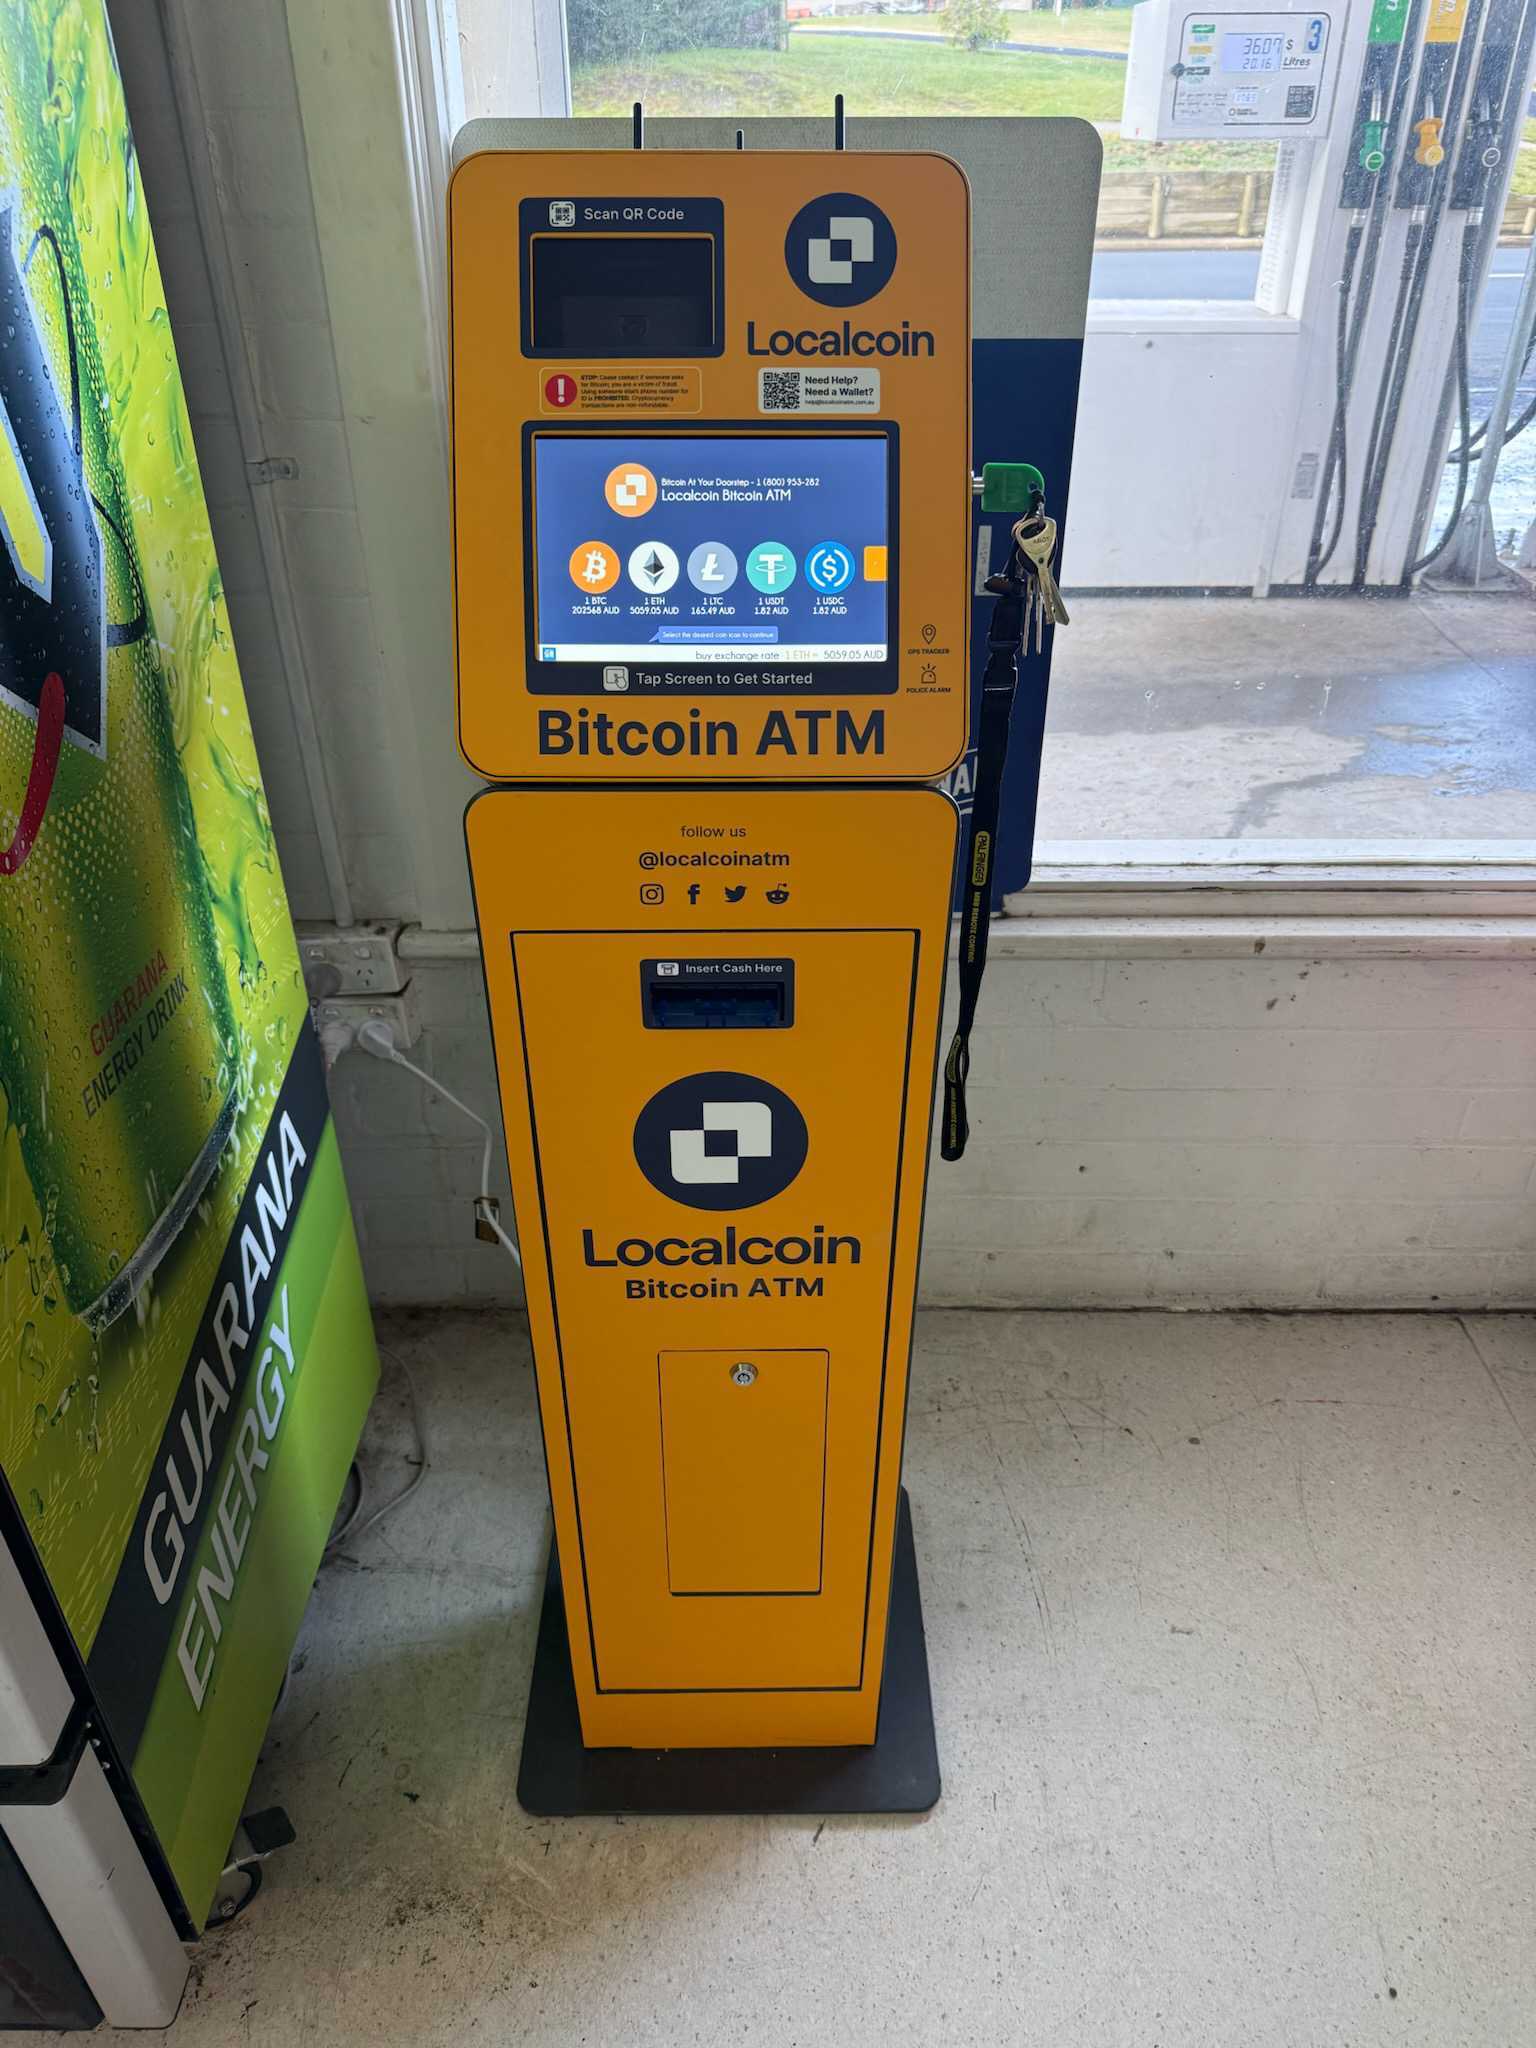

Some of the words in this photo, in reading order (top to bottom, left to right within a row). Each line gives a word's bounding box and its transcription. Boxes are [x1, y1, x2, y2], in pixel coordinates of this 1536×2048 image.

[1307, 19, 1322, 51] 3
[1282, 56, 1311, 67] Litres
[584, 207, 617, 222] Scan
[622, 207, 643, 222] QR
[646, 207, 685, 222] Code
[747, 320, 935, 357] Localcoin
[804, 375, 830, 385] Need
[831, 375, 859, 386] Help?
[804, 387, 830, 396] Need
[839, 387, 874, 396] Wallet?
[661, 477, 686, 487] Bitcoin
[687, 477, 697, 487] At
[698, 477, 714, 487] Your
[715, 477, 750, 487] Doorstep
[762, 477, 785, 488] (800)
[786, 477, 820, 487] 953-282
[661, 488, 720, 501] Localcoin
[722, 488, 763, 501] Bitcoin
[766, 488, 792, 501] ATM
[585, 597, 590, 605] 1
[591, 597, 608, 605] BTC
[644, 597, 649, 605] 1
[650, 597, 666, 605] ETH
[703, 597, 708, 605] 1
[709, 597, 723, 605] LTC
[758, 597, 762, 605] 1
[764, 597, 785, 605] USDT
[816, 597, 820, 605] 1
[821, 597, 845, 605] USDC
[603, 606, 620, 615] AUD
[629, 606, 661, 615] 5059.05
[662, 606, 680, 615] AUD
[690, 606, 717, 615] 165.49
[719, 606, 736, 615] AUD
[754, 606, 770, 615] 1.82
[771, 606, 790, 615] AUD
[812, 606, 829, 615] 1.82
[830, 606, 848, 615] AUD
[695, 650, 713, 661] buy
[714, 650, 759, 661] exchange
[760, 650, 780, 660] rate
[823, 649, 862, 660] 5059.05
[863, 649, 884, 660] AUD
[635, 673, 660, 686] Tap
[664, 672, 713, 685] Screen
[716, 673, 730, 685] to
[733, 672, 760, 685] Get
[761, 672, 813, 685] Started
[538, 708, 738, 757] Bitcoin
[755, 709, 886, 756] ATM
[680, 825, 725, 838] follow
[729, 828, 747, 838] us
[638, 850, 790, 870] @localcoinatm
[685, 963, 720, 974] Insert
[722, 963, 752, 974] Cash
[754, 963, 783, 974] Here
[89, 951, 169, 1057] GUARANA
[81, 1028, 150, 1119] ENERGY
[147, 971, 190, 1045] DRINK
[582, 1224, 862, 1268] Localcoin
[625, 1278, 739, 1300] Bitcoin
[747, 1277, 825, 1299] ATM
[144, 1110, 308, 1606] GUARANA
[176, 1283, 297, 1713] ENERGY
